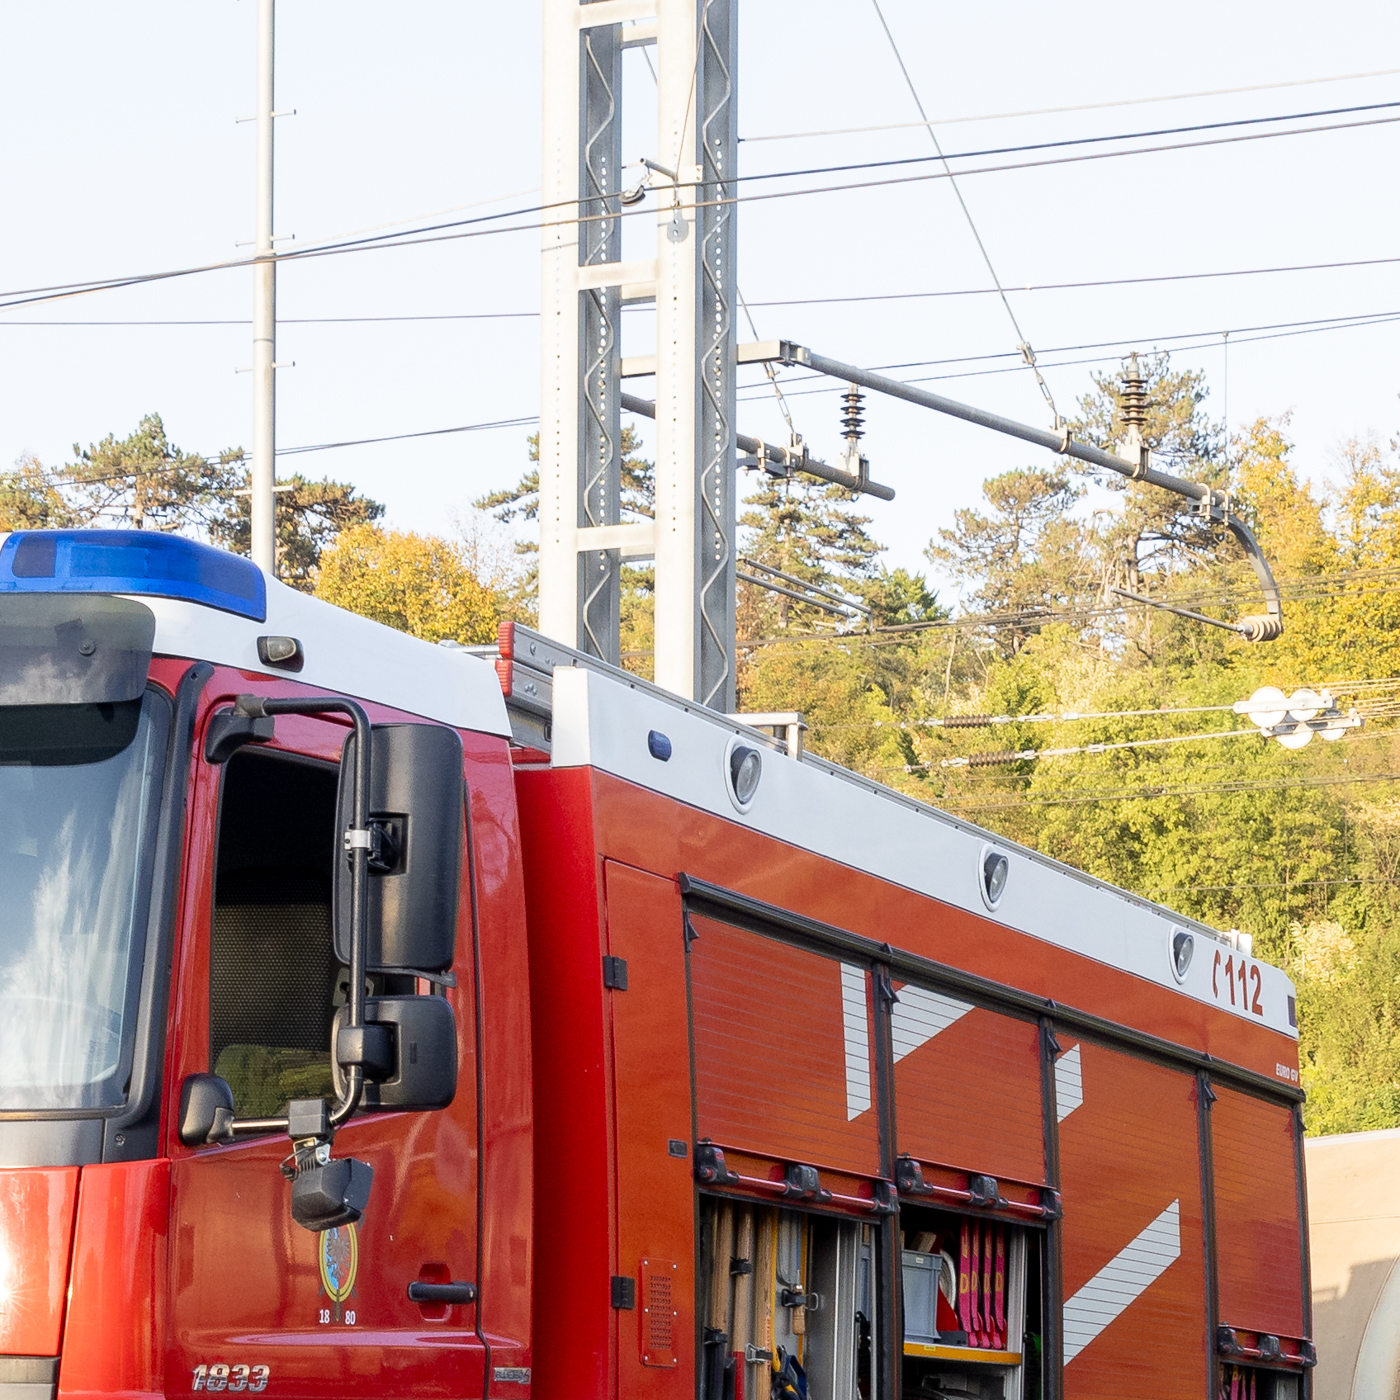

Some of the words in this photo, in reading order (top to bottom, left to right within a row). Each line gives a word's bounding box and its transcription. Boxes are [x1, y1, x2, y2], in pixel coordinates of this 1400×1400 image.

[1224, 954, 1263, 1017] 112
[1275, 1062, 1290, 1080] EURO
[318, 1308, 331, 1324] 18
[344, 1310, 357, 1326] 80
[191, 1362, 271, 1393] 1833
